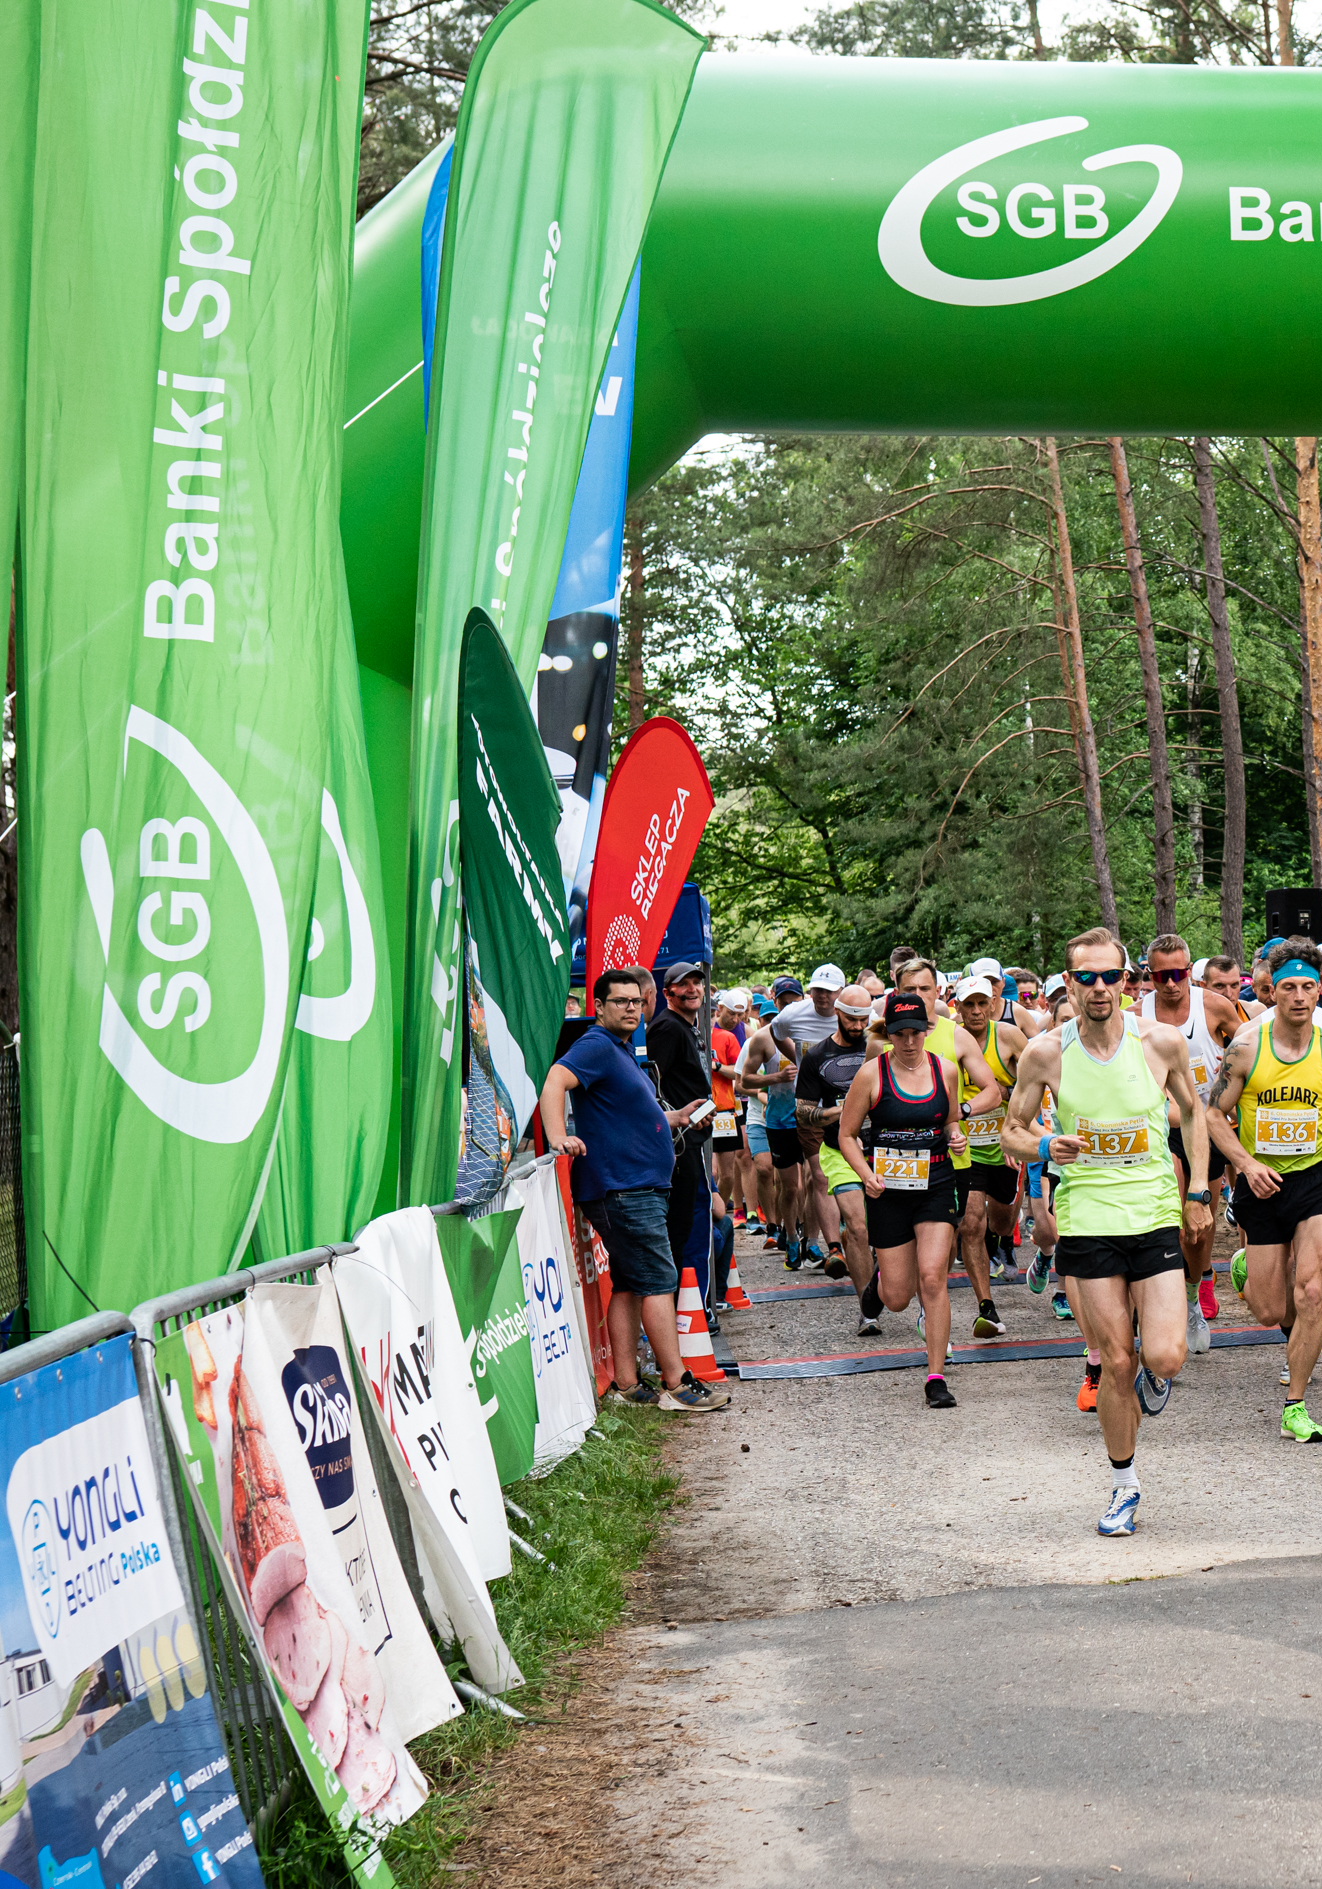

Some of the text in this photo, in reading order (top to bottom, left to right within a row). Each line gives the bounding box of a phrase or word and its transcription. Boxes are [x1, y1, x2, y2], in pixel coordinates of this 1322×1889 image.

[955, 181, 1110, 242] SGB
[143, 369, 226, 643] Banki
[630, 812, 661, 906] SKLEP
[137, 815, 212, 1034] SGB
[1256, 1086, 1319, 1109] KOLEJARZ
[967, 1119, 999, 1136] 222
[1089, 1131, 1137, 1154] 137
[1268, 1122, 1308, 1142] 136
[883, 1159, 920, 1178] 221
[120, 1540, 161, 1579] Polska
